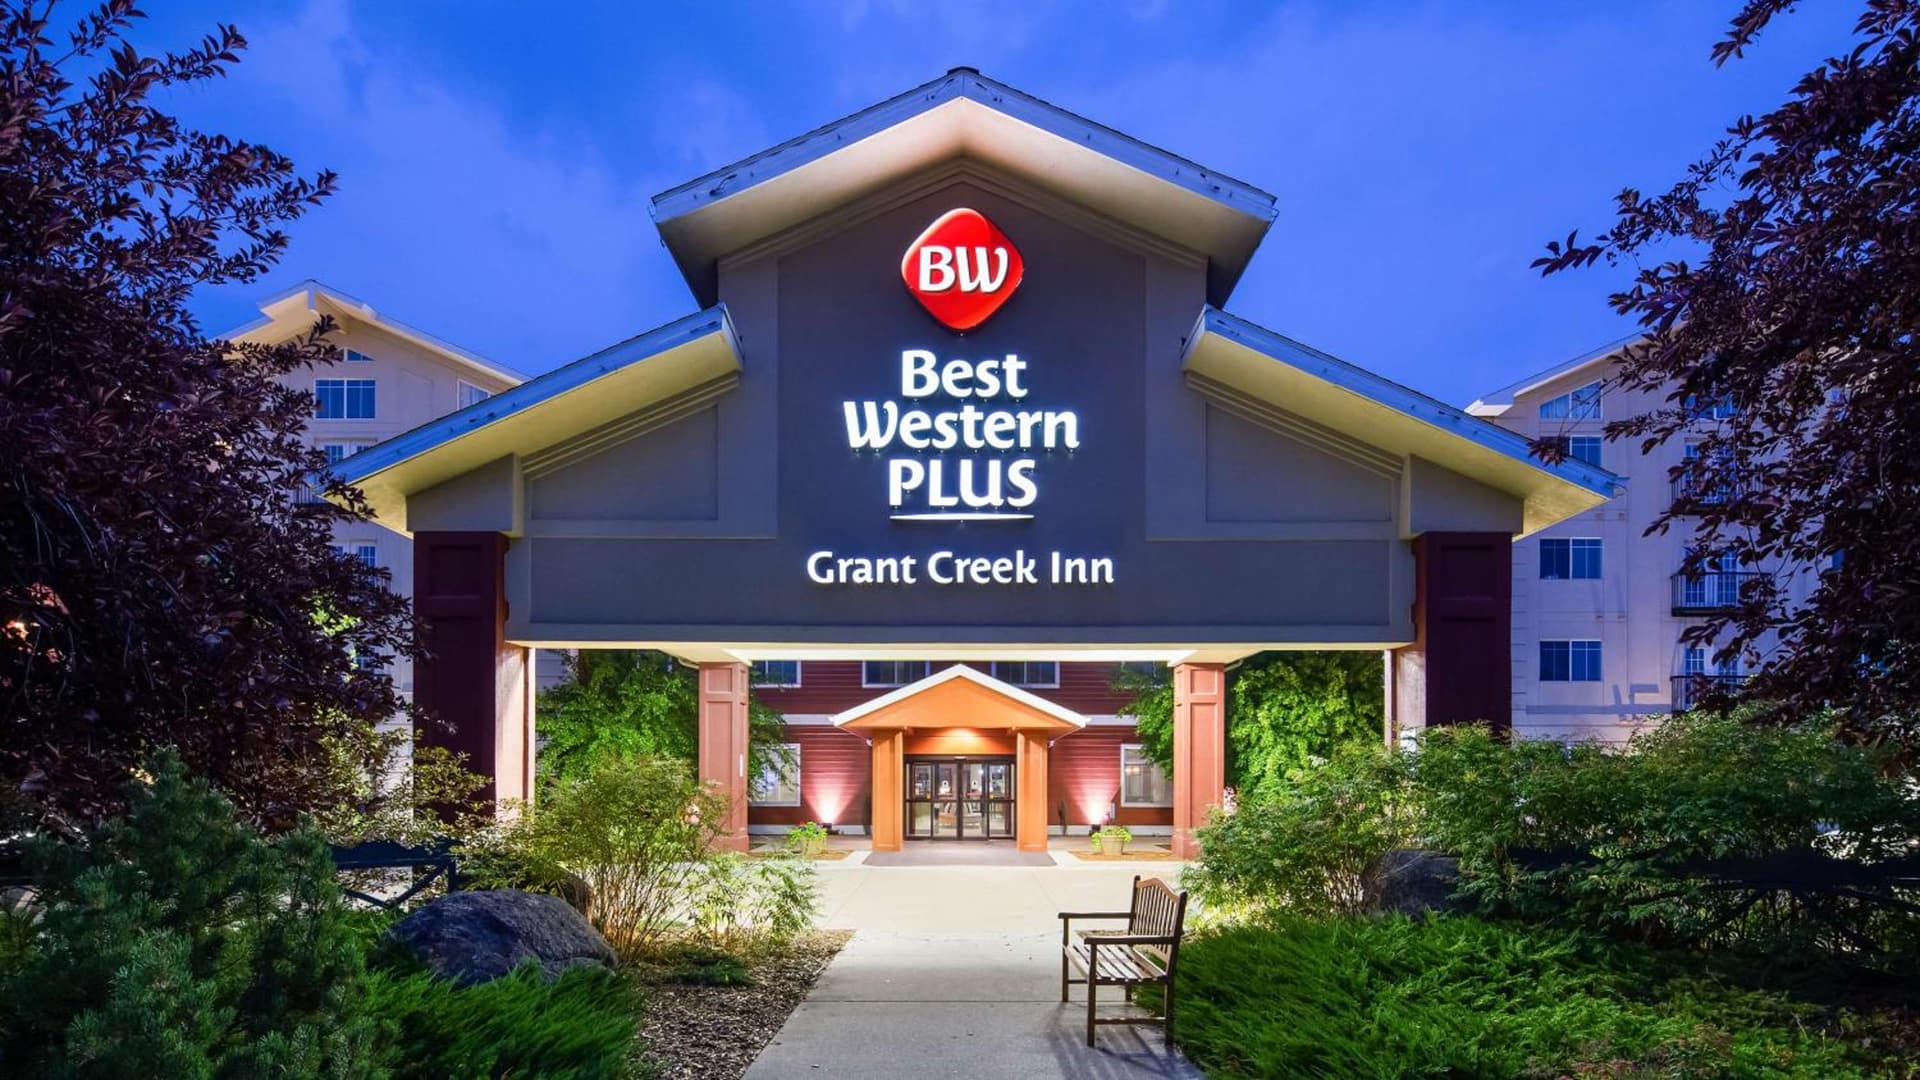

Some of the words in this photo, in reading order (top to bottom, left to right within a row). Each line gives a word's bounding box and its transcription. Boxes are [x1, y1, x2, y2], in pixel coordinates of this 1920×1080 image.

[919, 246, 1008, 292] BW
[901, 350, 1028, 398] Best
[843, 401, 1080, 449] Western
[889, 459, 1038, 507] PLUS
[807, 551, 917, 584] Grant
[927, 550, 1038, 584] Creek
[1051, 552, 1115, 584] Inn
